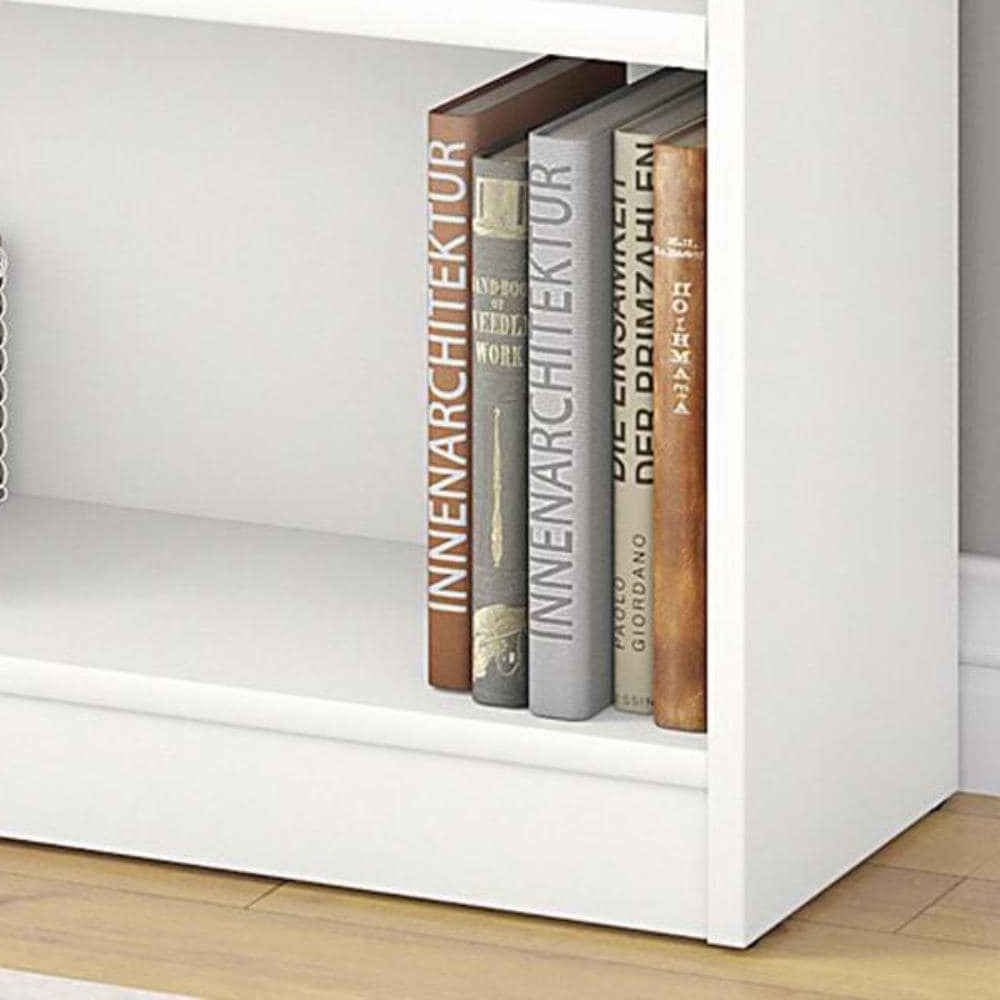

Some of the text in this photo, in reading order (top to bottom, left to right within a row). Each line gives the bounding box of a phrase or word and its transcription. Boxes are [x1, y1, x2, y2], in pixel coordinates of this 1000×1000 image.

[428, 139, 467, 613] INNENARCHITEKTUR
[476, 341, 523, 368] WORK
[530, 161, 574, 641] INNENARCHITEKTUR
[635, 410, 654, 485] DER
[632, 534, 646, 652] GIORDANO
